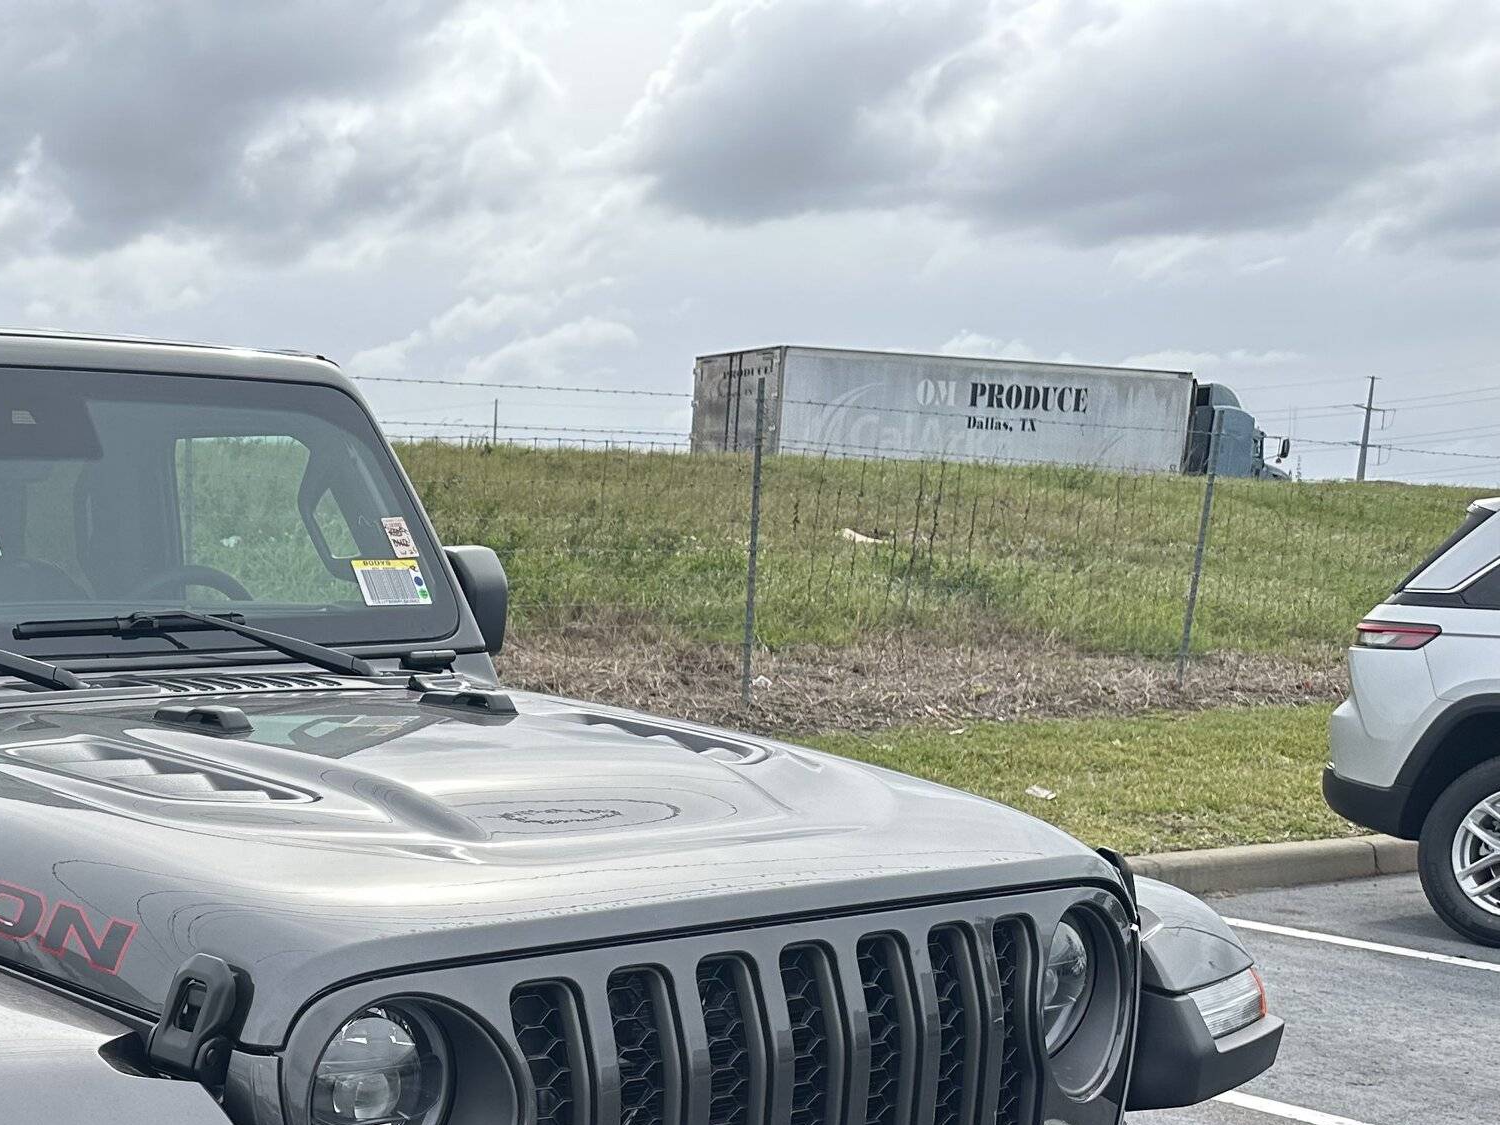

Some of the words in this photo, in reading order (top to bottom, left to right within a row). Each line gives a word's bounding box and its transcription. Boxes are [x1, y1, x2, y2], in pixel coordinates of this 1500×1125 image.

[916, 378, 956, 407] OM
[968, 382, 1089, 414] PRODUCE
[967, 416, 1013, 432] Dallas,
[1019, 418, 1038, 432] TX
